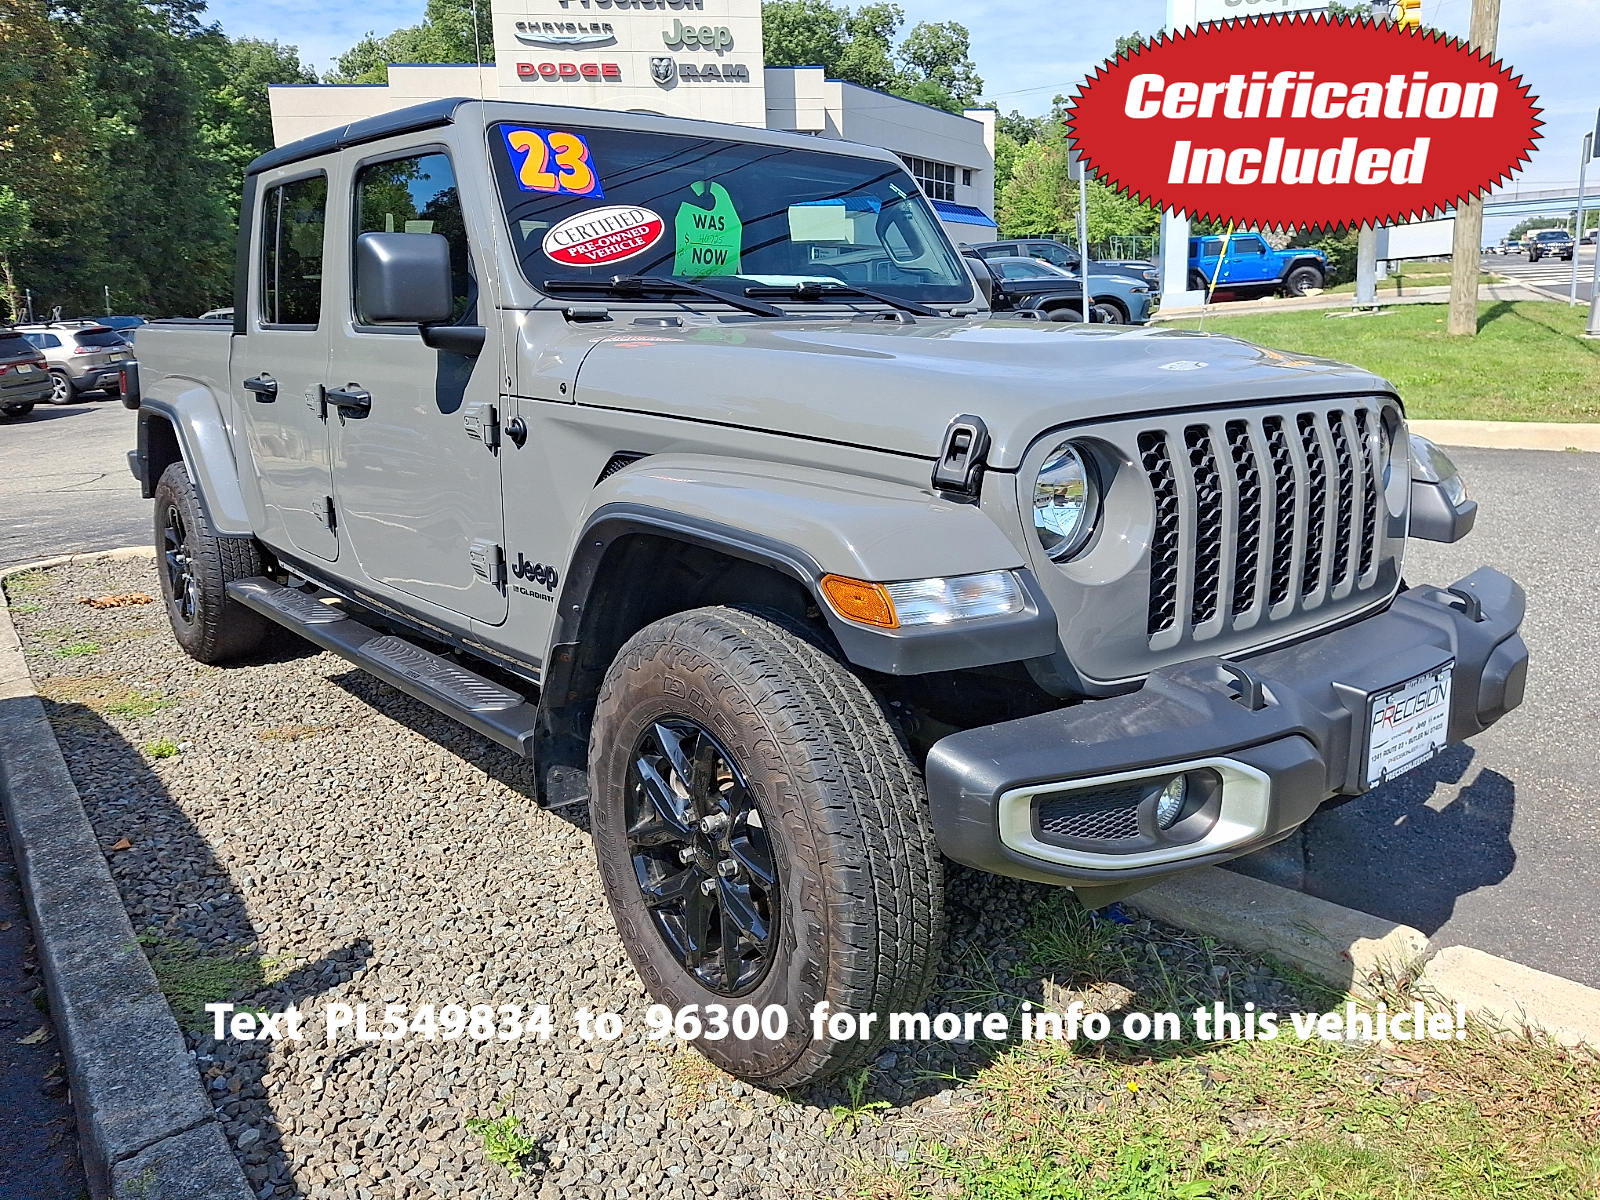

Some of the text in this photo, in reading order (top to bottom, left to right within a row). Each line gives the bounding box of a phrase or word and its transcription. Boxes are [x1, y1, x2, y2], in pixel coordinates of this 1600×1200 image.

[515, 21, 614, 34] CHRYSLER
[662, 18, 732, 50] Jeep
[516, 62, 619, 77] DODGE
[678, 63, 748, 78] RAM
[507, 130, 596, 194] 23
[553, 208, 645, 247] CERTIFIED
[692, 213, 725, 232] WAS
[567, 225, 650, 257] PRE-OWNED
[585, 236, 646, 261] VEHICLE
[691, 247, 728, 266] NOW
[512, 552, 559, 593] Jeep
[1372, 680, 1448, 733] PRECISION
[1408, 732, 1424, 746] BUTLER
